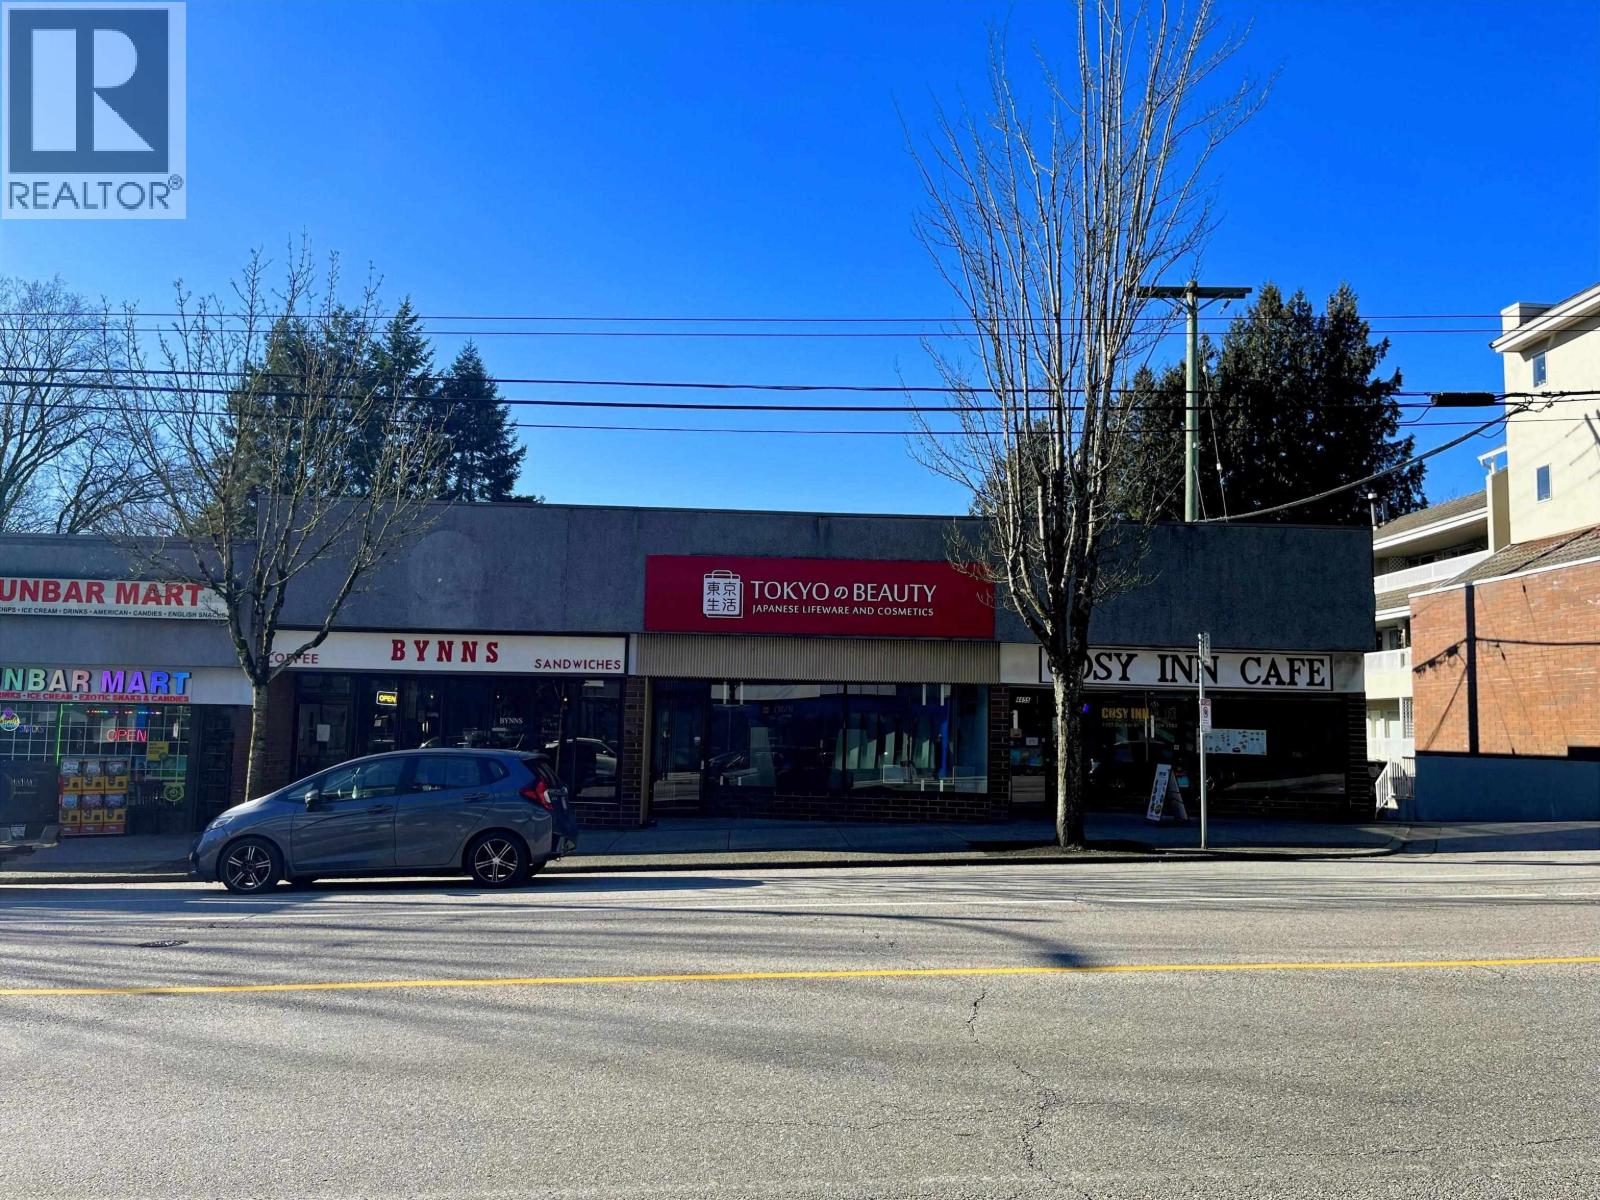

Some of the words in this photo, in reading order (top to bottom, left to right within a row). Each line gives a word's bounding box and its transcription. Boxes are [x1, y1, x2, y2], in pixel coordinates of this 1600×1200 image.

[0, 579, 105, 604] UNBAR
[115, 582, 204, 607] MART
[707, 581, 737, 596] 東京
[750, 581, 830, 601] TOKYO
[834, 585, 849, 600] の
[853, 583, 937, 603] BEAUTY
[0, 606, 16, 614] HIPS
[21, 606, 32, 614] ICE
[34, 607, 58, 615] CREAM
[707, 598, 737, 612] 生活
[752, 604, 800, 614] JAPANESE
[802, 605, 850, 615] LIFEWARE
[852, 606, 874, 616] AND
[877, 607, 934, 617] COSMETICS
[391, 639, 499, 663] BYNNS
[269, 653, 319, 664] OFFEE
[534, 659, 621, 671] SANDWICHES
[1157, 654, 1220, 685] INN
[1239, 656, 1326, 687] CAFE
[100, 670, 191, 695] MART
[27, 692, 41, 700] ICE
[152, 695, 189, 703] CANDIES
[379, 695, 397, 703] OPEN
[106, 729, 148, 742] OPEN
